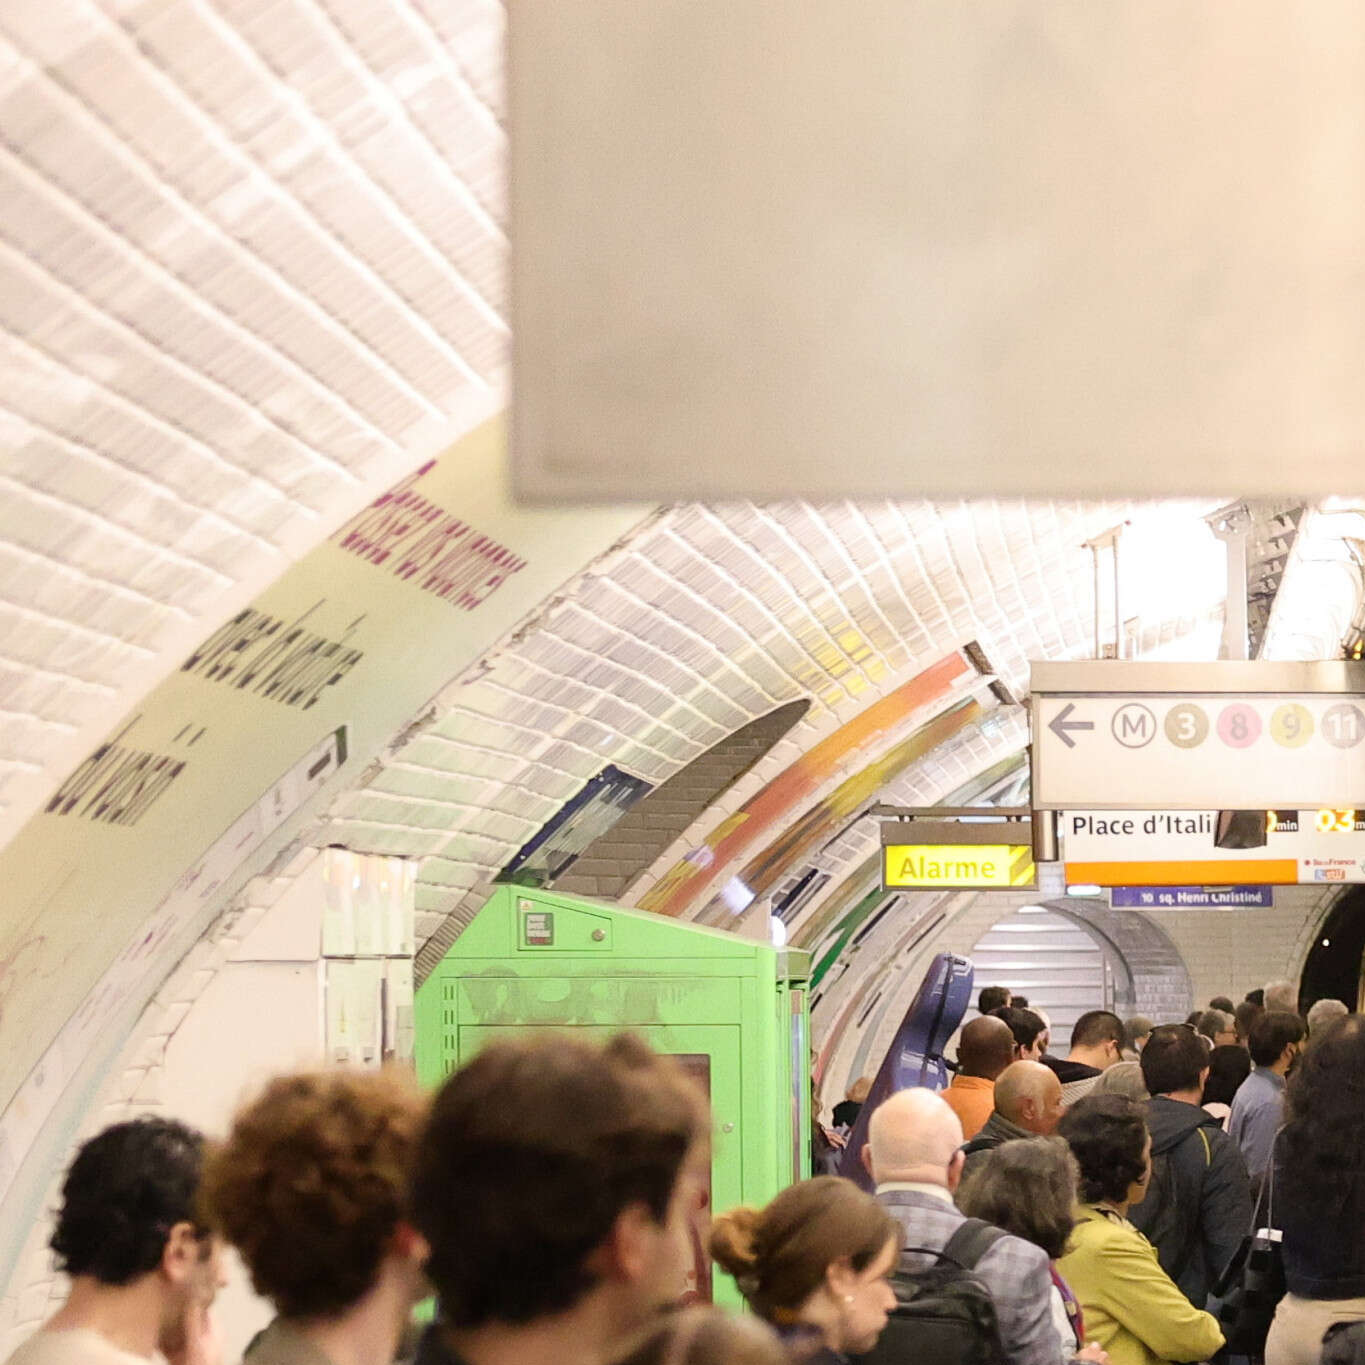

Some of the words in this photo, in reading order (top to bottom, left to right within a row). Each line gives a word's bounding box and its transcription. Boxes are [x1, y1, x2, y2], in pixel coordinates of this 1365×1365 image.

[1327, 712, 1360, 742] 11
[1072, 815, 1135, 835] Place
[1143, 814, 1212, 835] d'Itali
[1277, 820, 1298, 832] min
[1315, 809, 1355, 832] 03
[899, 855, 996, 879] Alarme
[1159, 893, 1175, 906] sq.
[1177, 891, 1209, 904] Henri
